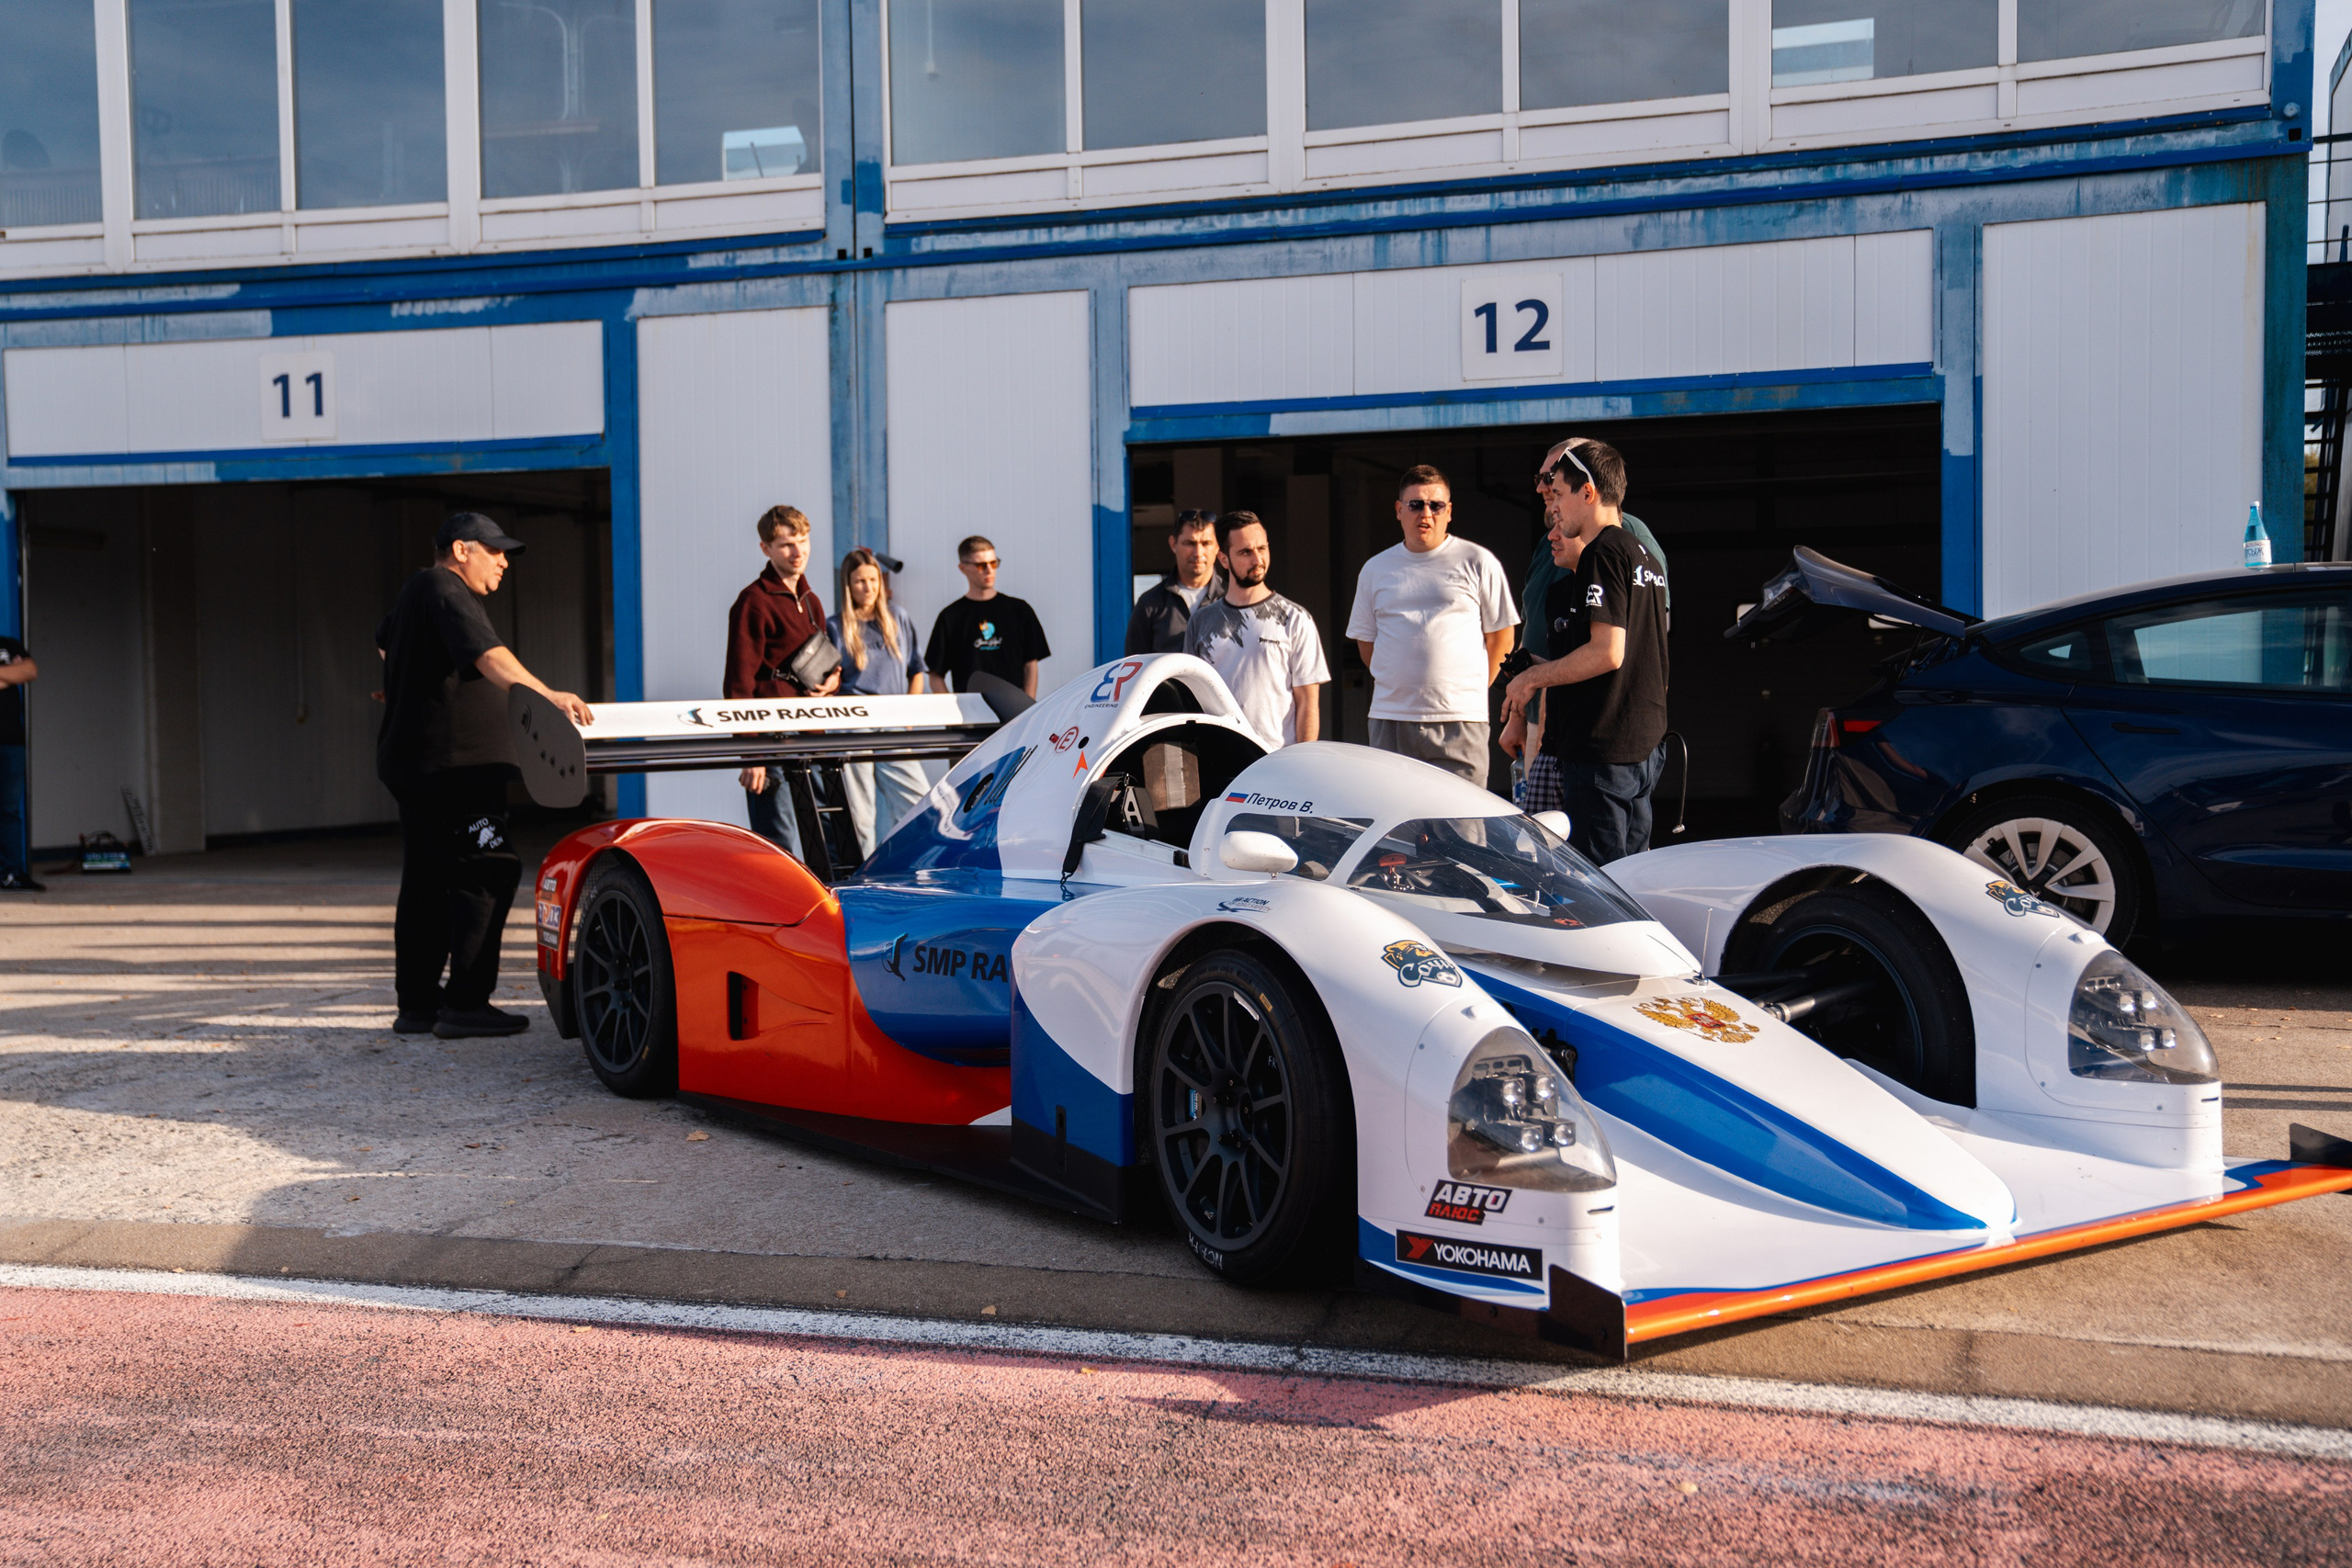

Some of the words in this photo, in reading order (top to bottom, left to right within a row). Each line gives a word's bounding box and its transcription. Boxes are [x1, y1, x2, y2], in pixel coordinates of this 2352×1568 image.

[1474, 299, 1550, 354] 12
[273, 372, 323, 419] 11
[717, 709, 772, 722] SMP
[776, 705, 869, 720] RACING
[1247, 793, 1298, 810] Петров
[1299, 800, 1314, 815] В.
[913, 945, 967, 977] SMP
[1429, 1201, 1480, 1223] ПЛЮС
[1434, 1183, 1507, 1211] АВТО
[1433, 1242, 1532, 1274] YOKOHAMA
